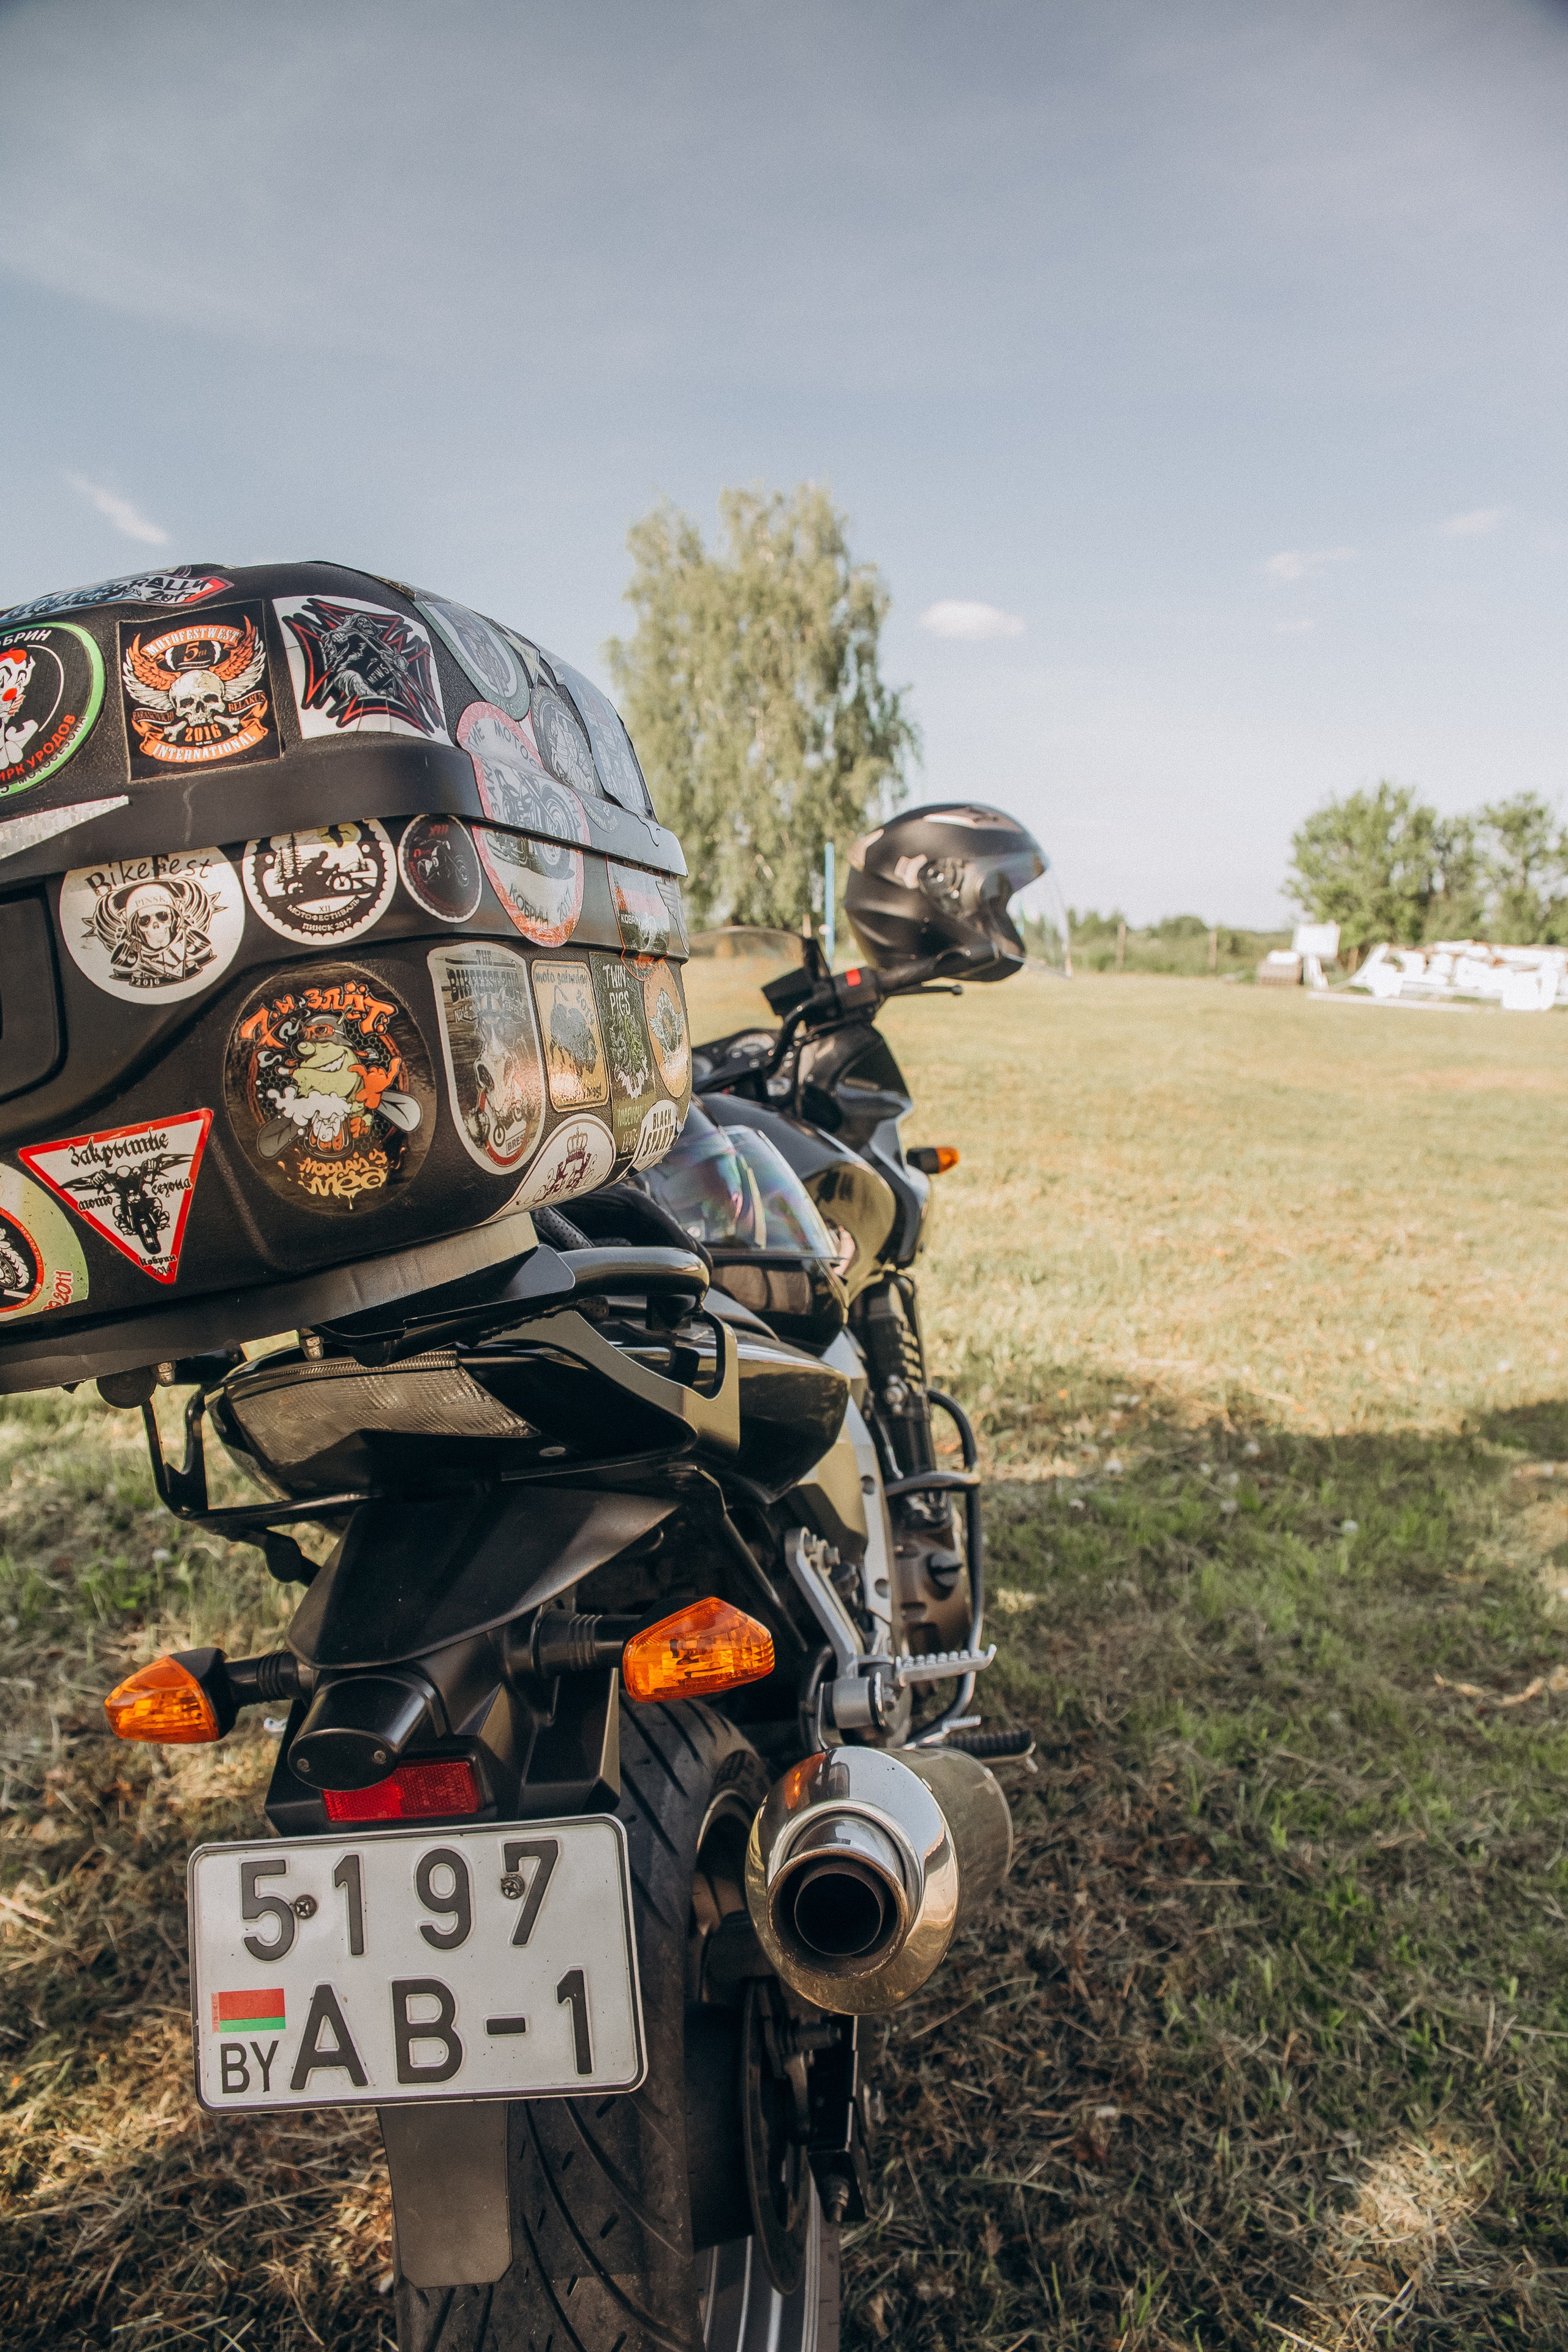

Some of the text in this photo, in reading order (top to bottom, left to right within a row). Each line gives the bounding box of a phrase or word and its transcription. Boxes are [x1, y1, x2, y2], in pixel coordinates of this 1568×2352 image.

[146, 590, 197, 603] 2017
[0, 629, 51, 646] БРИН
[26, 714, 75, 769] УРОДОВ
[184, 723, 222, 742] 2016
[152, 732, 256, 761] INTERNATIONAL
[287, 898, 360, 921] МОТОФЕСТИВАЛЬ
[302, 918, 353, 932] ПИНСК 2017
[135, 978, 160, 987] 2016
[609, 990, 631, 1016] PIGS
[653, 1108, 672, 1130] BLACK
[68, 1128, 169, 1167] Закрытие
[507, 1134, 527, 1152] BRES
[151, 1265, 173, 1276] 2014
[241, 1839, 559, 1962] 5197
[289, 1969, 594, 2090] AB-1
[221, 2039, 279, 2094] BY
